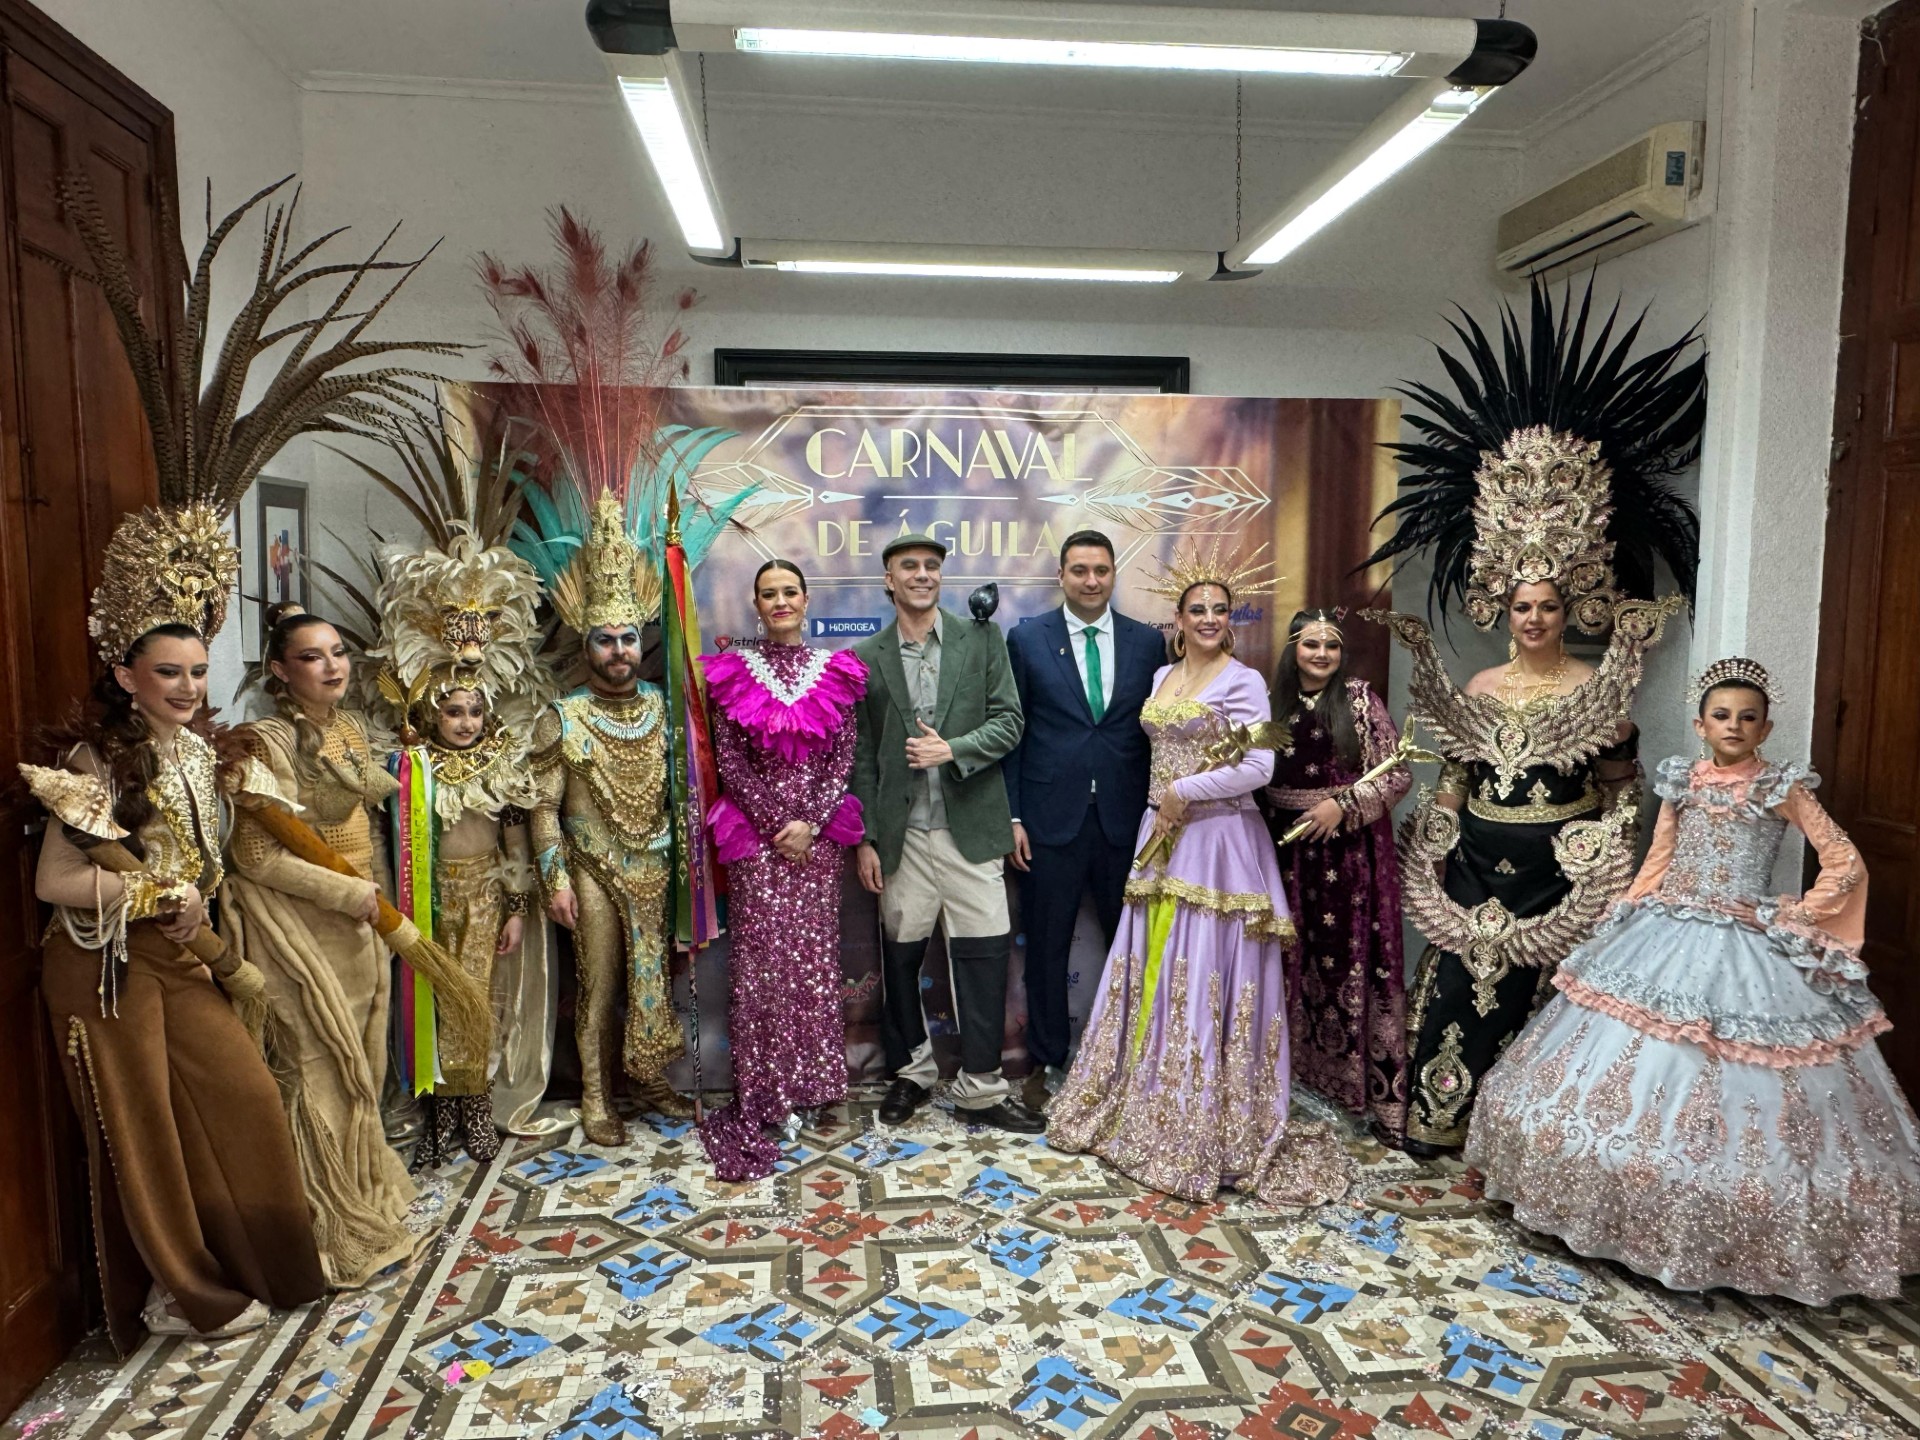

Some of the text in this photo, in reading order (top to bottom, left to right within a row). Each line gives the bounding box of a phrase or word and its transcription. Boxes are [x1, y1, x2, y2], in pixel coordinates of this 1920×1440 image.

[805, 428, 1093, 481] CARNAVAL
[818, 508, 1092, 558] DE ÁGUILA
